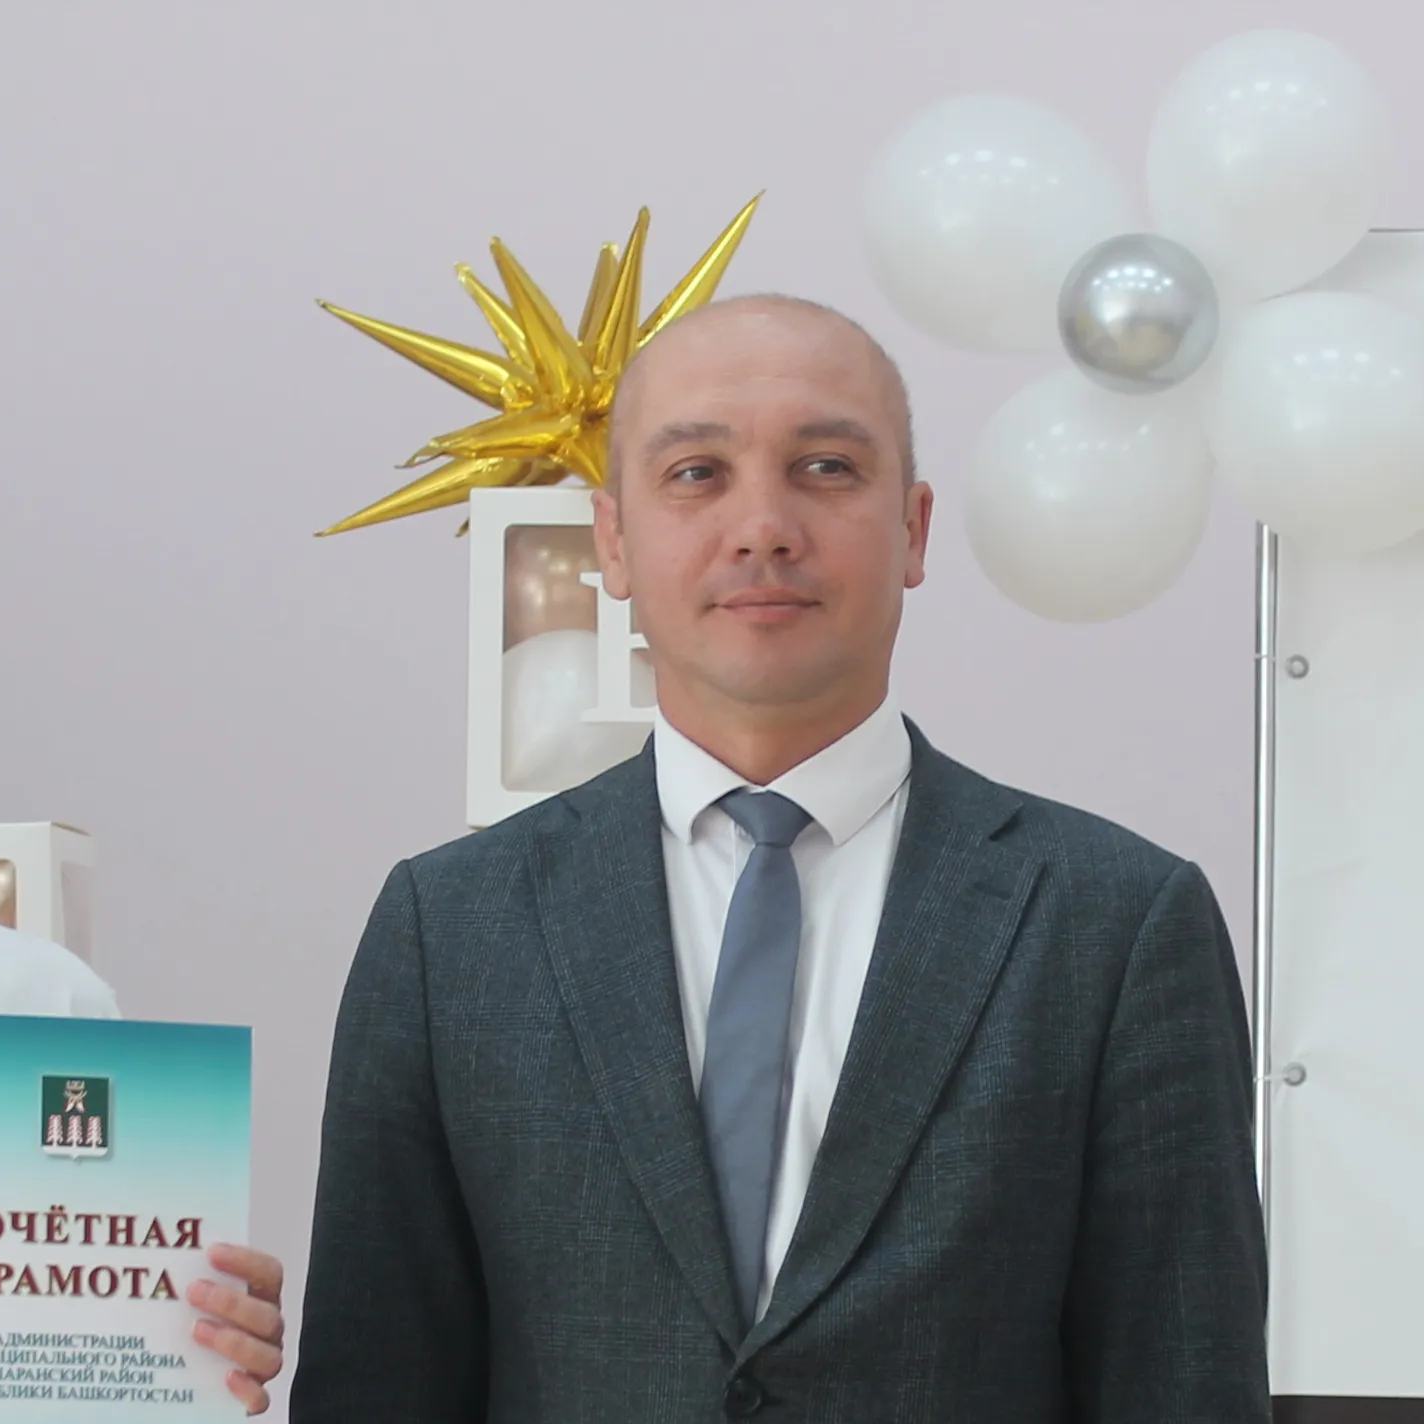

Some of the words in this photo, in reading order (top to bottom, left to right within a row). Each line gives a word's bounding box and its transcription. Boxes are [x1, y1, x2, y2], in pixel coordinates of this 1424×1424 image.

[120, 1351, 186, 1369] РАЙОНА
[99, 1367, 154, 1385] РАЙОН
[57, 1386, 194, 1404] БАШКОРТОСТАН
